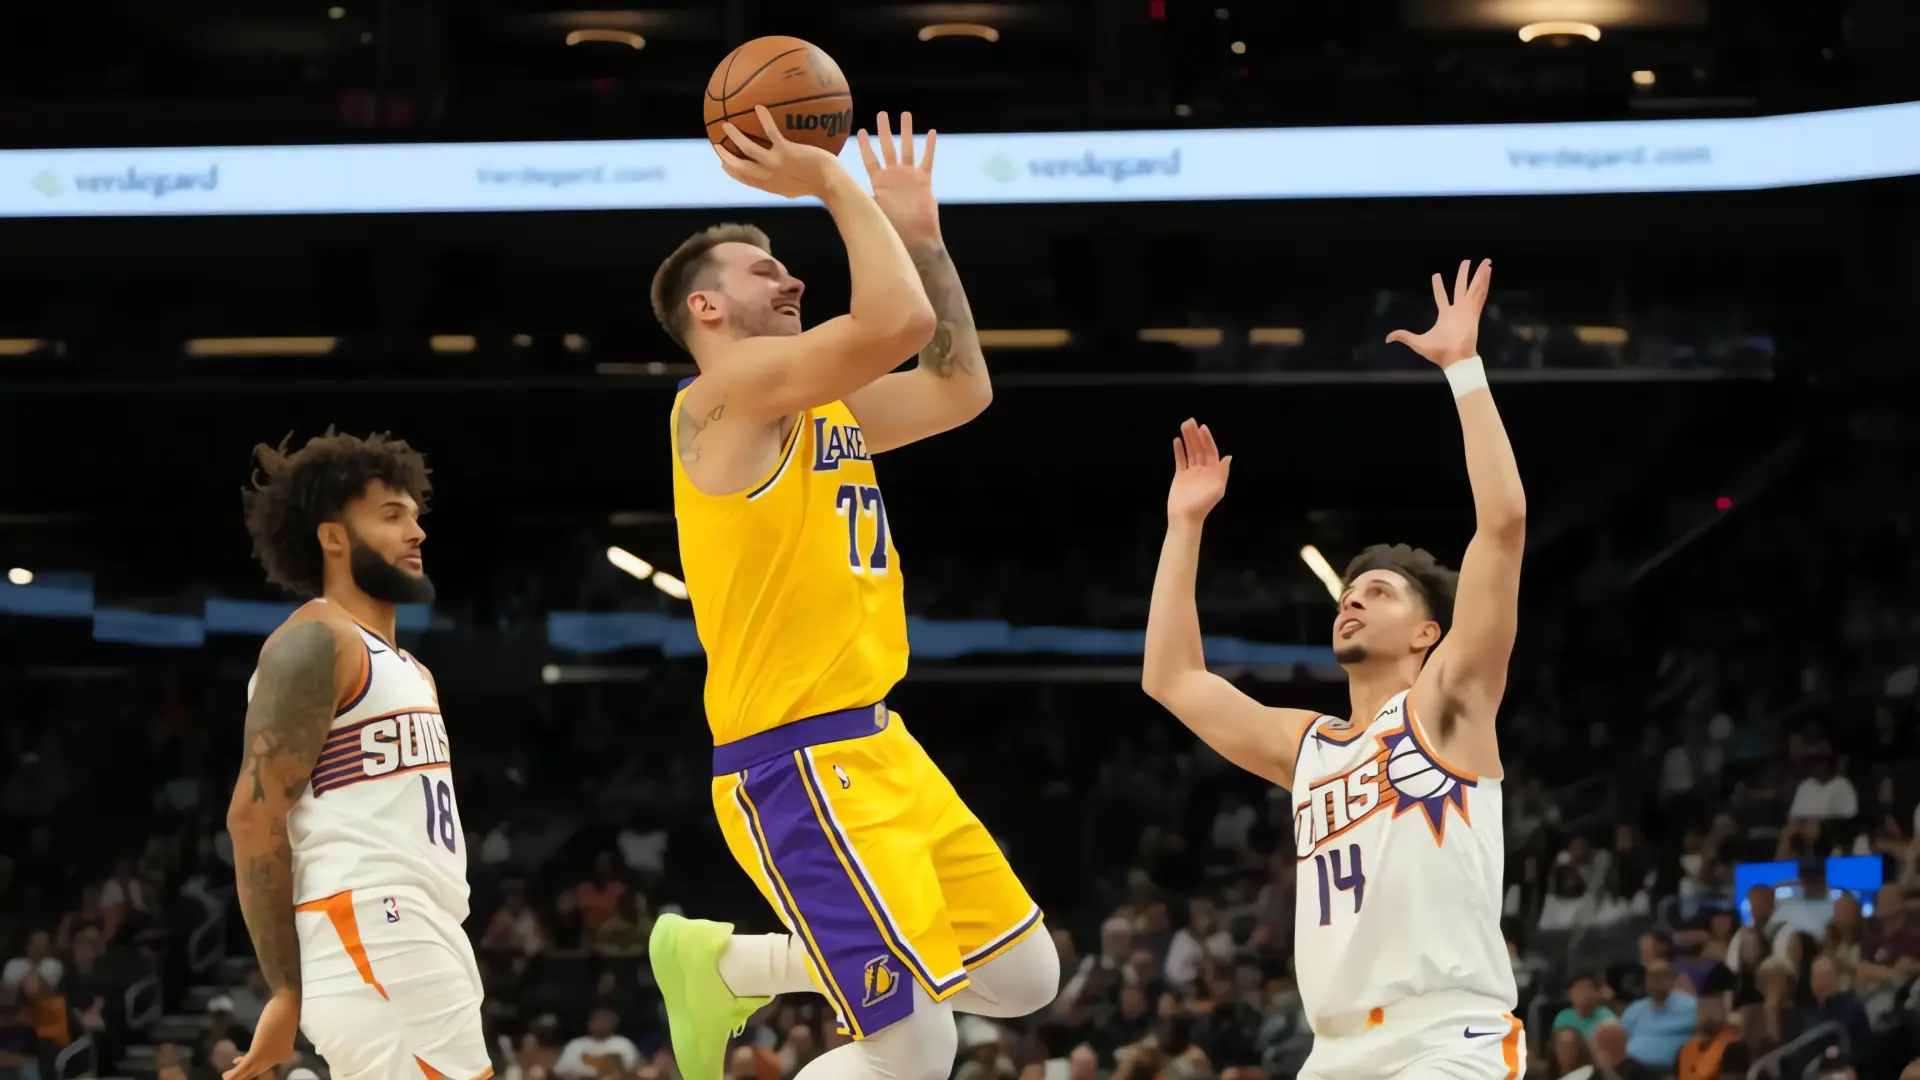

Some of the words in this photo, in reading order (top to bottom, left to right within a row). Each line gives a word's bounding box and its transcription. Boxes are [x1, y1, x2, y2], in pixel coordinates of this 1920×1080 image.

[836, 484, 888, 575] 77
[420, 774, 456, 854] 18
[1314, 843, 1365, 926] 14
